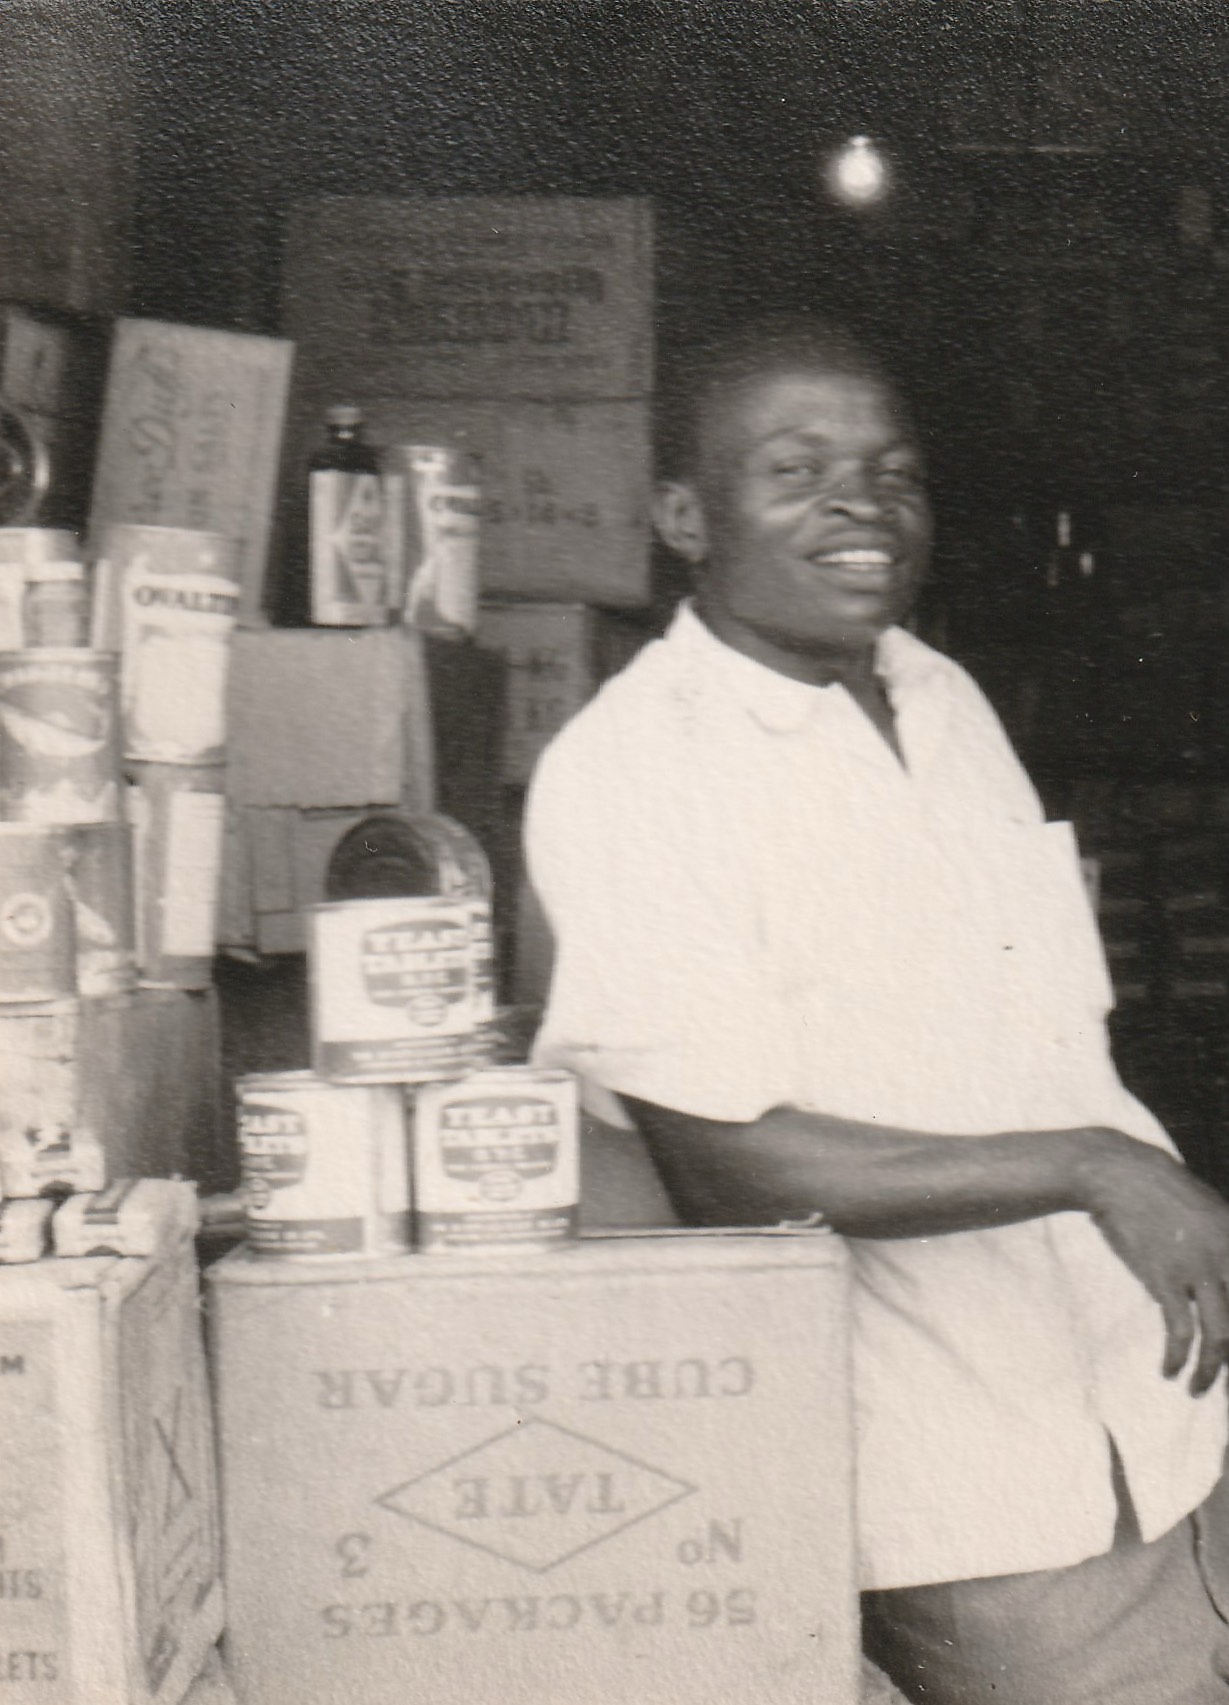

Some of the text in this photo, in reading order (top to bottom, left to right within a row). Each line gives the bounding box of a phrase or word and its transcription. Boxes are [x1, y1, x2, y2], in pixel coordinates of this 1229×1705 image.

[311, 1355, 757, 1410] CUBE SUGAR
[454, 1472, 627, 1520] TATE
[333, 1531, 374, 1579] 3
[319, 1587, 760, 1641] 56 PACKAGES
